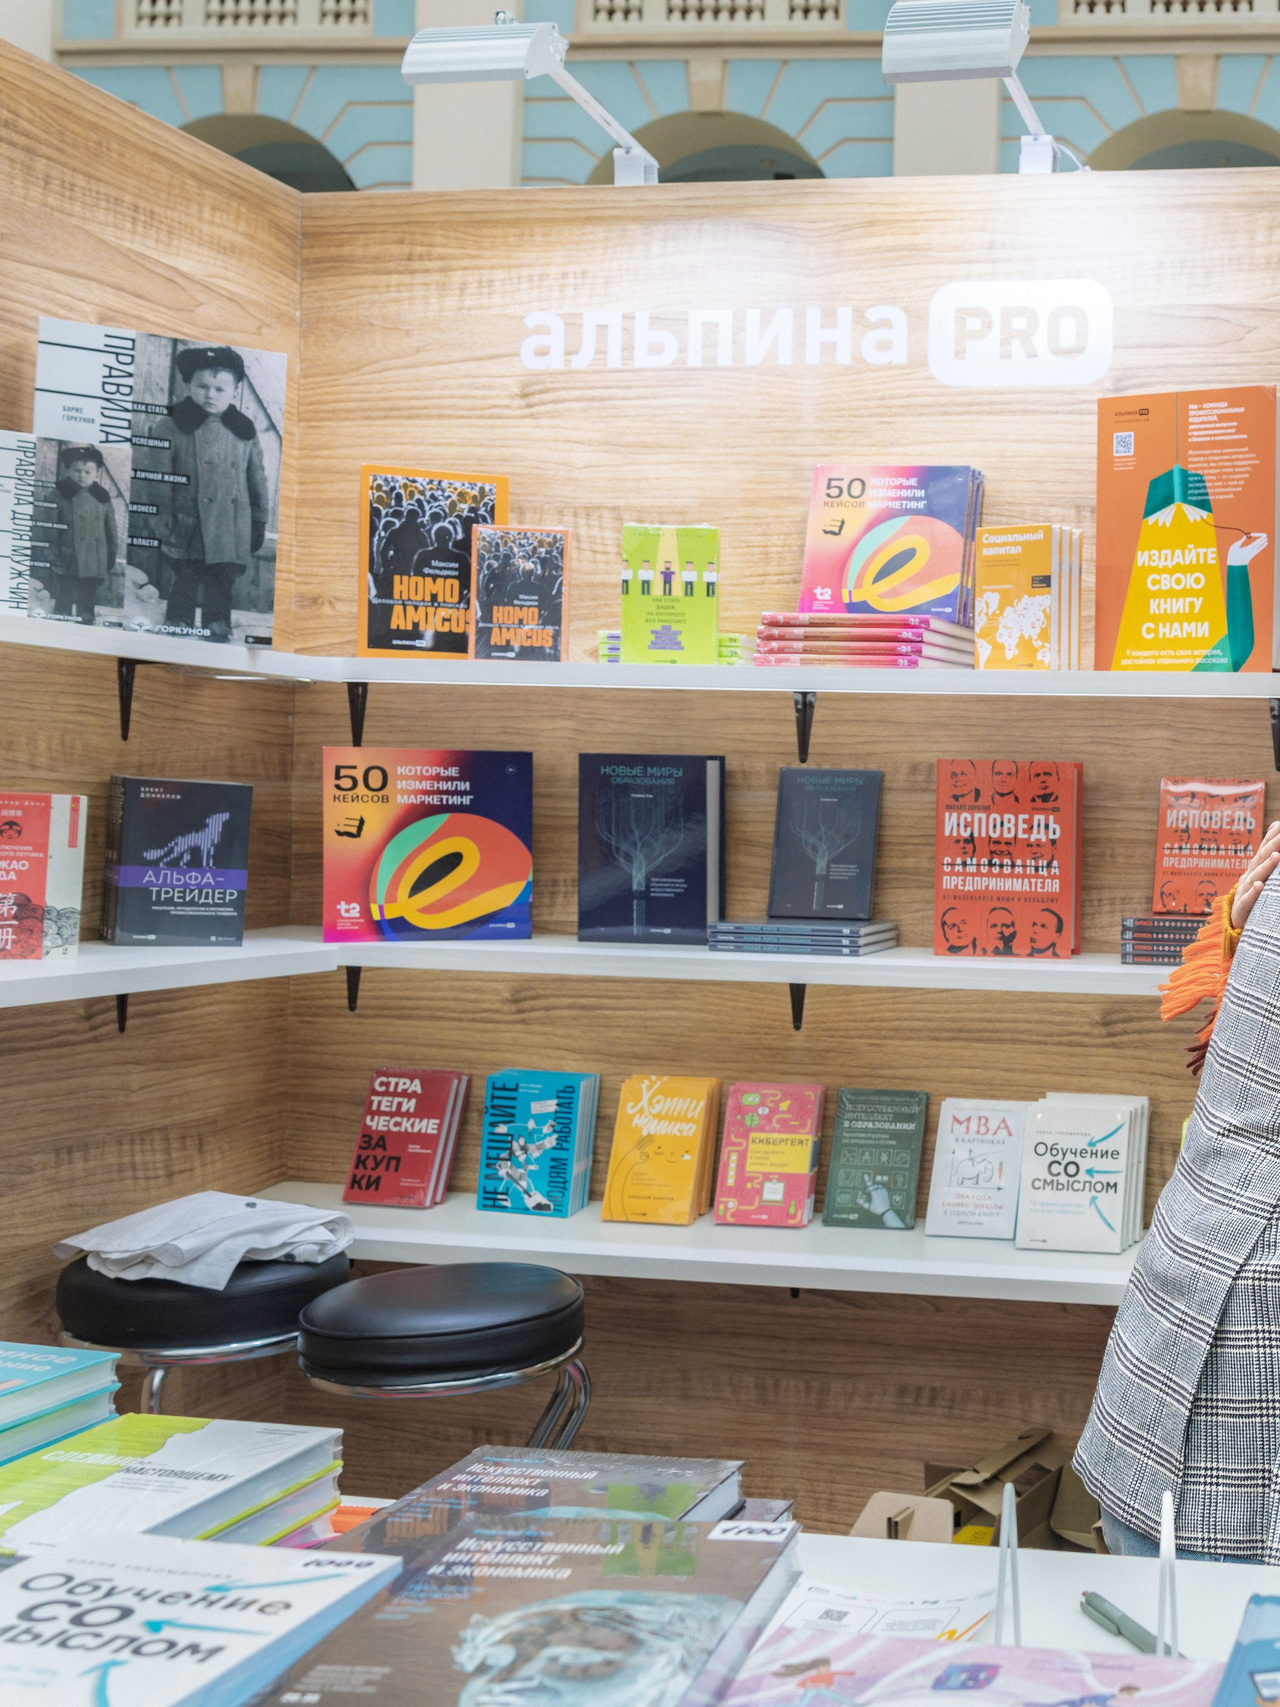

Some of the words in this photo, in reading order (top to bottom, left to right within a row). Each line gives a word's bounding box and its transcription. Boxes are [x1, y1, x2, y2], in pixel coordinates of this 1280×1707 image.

[520, 304, 908, 370] альпина
[954, 305, 1089, 360] PRO
[99, 334, 135, 443] ПРАВИЛА
[62, 405, 83, 414] БОРИС
[133, 403, 146, 412] КАК
[147, 405, 168, 415] СТАТЬ
[62, 414, 95, 424] ГОРКУНОВ
[132, 437, 169, 448] УСПЕШНЫМ
[14, 440, 36, 506] ПРАВИЛА
[825, 478, 866, 498] 50
[870, 477, 917, 487] КОТОРЫЕ
[869, 488, 925, 498] ИЗМЕНИЛИ
[129, 504, 157, 514] БИЗНЕСЕ
[823, 499, 866, 509] КЕЙСОВ
[867, 500, 927, 510] МАРКЕТИНГ
[11, 510, 33, 541] ДЛЯ
[982, 530, 1044, 544] Социальный
[982, 546, 1022, 555] капитал
[1137, 545, 1216, 569] ИЗДАЙТЕ
[423, 567, 459, 576] Фельдман
[431, 560, 459, 568] Максим
[8, 545, 31, 610] МУЖЧИН
[1147, 573, 1205, 590] СВОЮ
[393, 575, 460, 603] HOMO
[1149, 597, 1204, 615] КНИГУ
[492, 605, 539, 625] HOMO
[155, 624, 211, 637] ГОРКУНОВ
[490, 628, 553, 647] AMICUS
[1141, 623, 1155, 639] С
[1158, 622, 1210, 639] НАМИ
[333, 765, 389, 792] 50
[397, 766, 459, 777] КОТОРЫЕ
[600, 766, 644, 776] НОВЫЕ
[647, 767, 683, 777] МИРЫ
[397, 780, 470, 791] ИЗМЕНИЛИ
[611, 777, 675, 785] ОБРАЗОВАНИЯ
[797, 776, 832, 785] НОВЫЕ
[835, 777, 864, 786] МИРЫ
[333, 791, 390, 804] КЕЙСОВ
[396, 794, 474, 805] МАРКЕТИНГ
[944, 812, 1061, 842] ИСПОВЕДЬ
[1166, 809, 1256, 832] ИСПОВЕДЬ
[1163, 842, 1254, 857] САМОЗВАНЦА
[943, 857, 1060, 877] САМОЗВАНЦА
[943, 876, 1060, 893] ПРЕДПРИНИМАТЕЛЯ
[149, 886, 238, 904] ТРЕЙДЕР
[374, 1077, 422, 1094] СТРА
[371, 1095, 417, 1113] ТЕГИ
[365, 1115, 440, 1134] ЧЕСКИЕ
[552, 1085, 575, 1152] РАБОТАТЬ
[851, 1121, 916, 1130] ОБРАЗОВАНИИ
[950, 1114, 1013, 1137] MBA
[483, 1082, 519, 1181] МЕШАЙТЕ
[360, 1134, 387, 1152] ЗА
[1034, 1141, 1120, 1161] Обучение
[354, 1154, 402, 1173] КУП
[350, 1173, 382, 1191] КИ
[546, 1157, 568, 1213] ЛЮДЯМ
[1031, 1178, 1118, 1194] СМЫСЛОМ
[482, 1186, 509, 1209] НЕ
[120, 1465, 235, 1482] НАСТОЯЩЕМУ
[451, 1473, 544, 1486] интеллект
[466, 1463, 599, 1480] Искусственный
[437, 1483, 447, 1491] и
[452, 1483, 550, 1497] экономика
[720, 1524, 787, 1538] 1100
[455, 1537, 625, 1555] Искусственный
[302, 1557, 375, 1570] 1000
[441, 1552, 560, 1566] интеллект
[427, 1565, 441, 1576] и
[447, 1566, 572, 1580] экономика
[20, 1572, 292, 1616] Обучение
